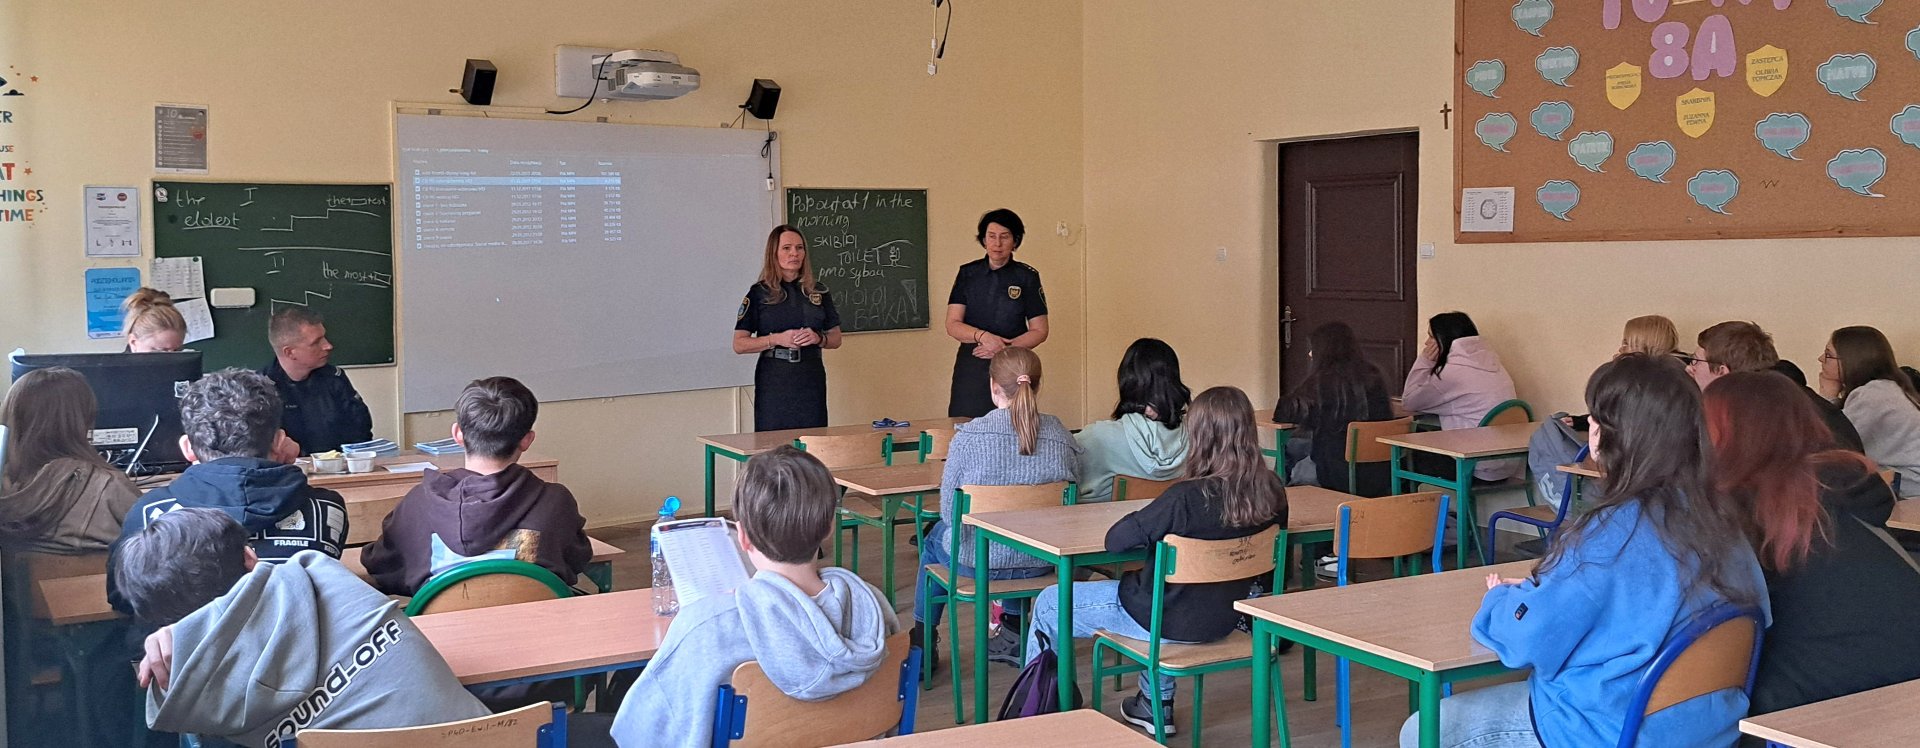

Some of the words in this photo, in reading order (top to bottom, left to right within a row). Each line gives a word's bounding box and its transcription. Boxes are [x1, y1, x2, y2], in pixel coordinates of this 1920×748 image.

[1648, 14, 1737, 81] 8A
[876, 194, 887, 208] in
[889, 193, 913, 208] the
[797, 214, 850, 230] morning
[322, 261, 339, 279] the
[274, 539, 309, 547] FRAGILE
